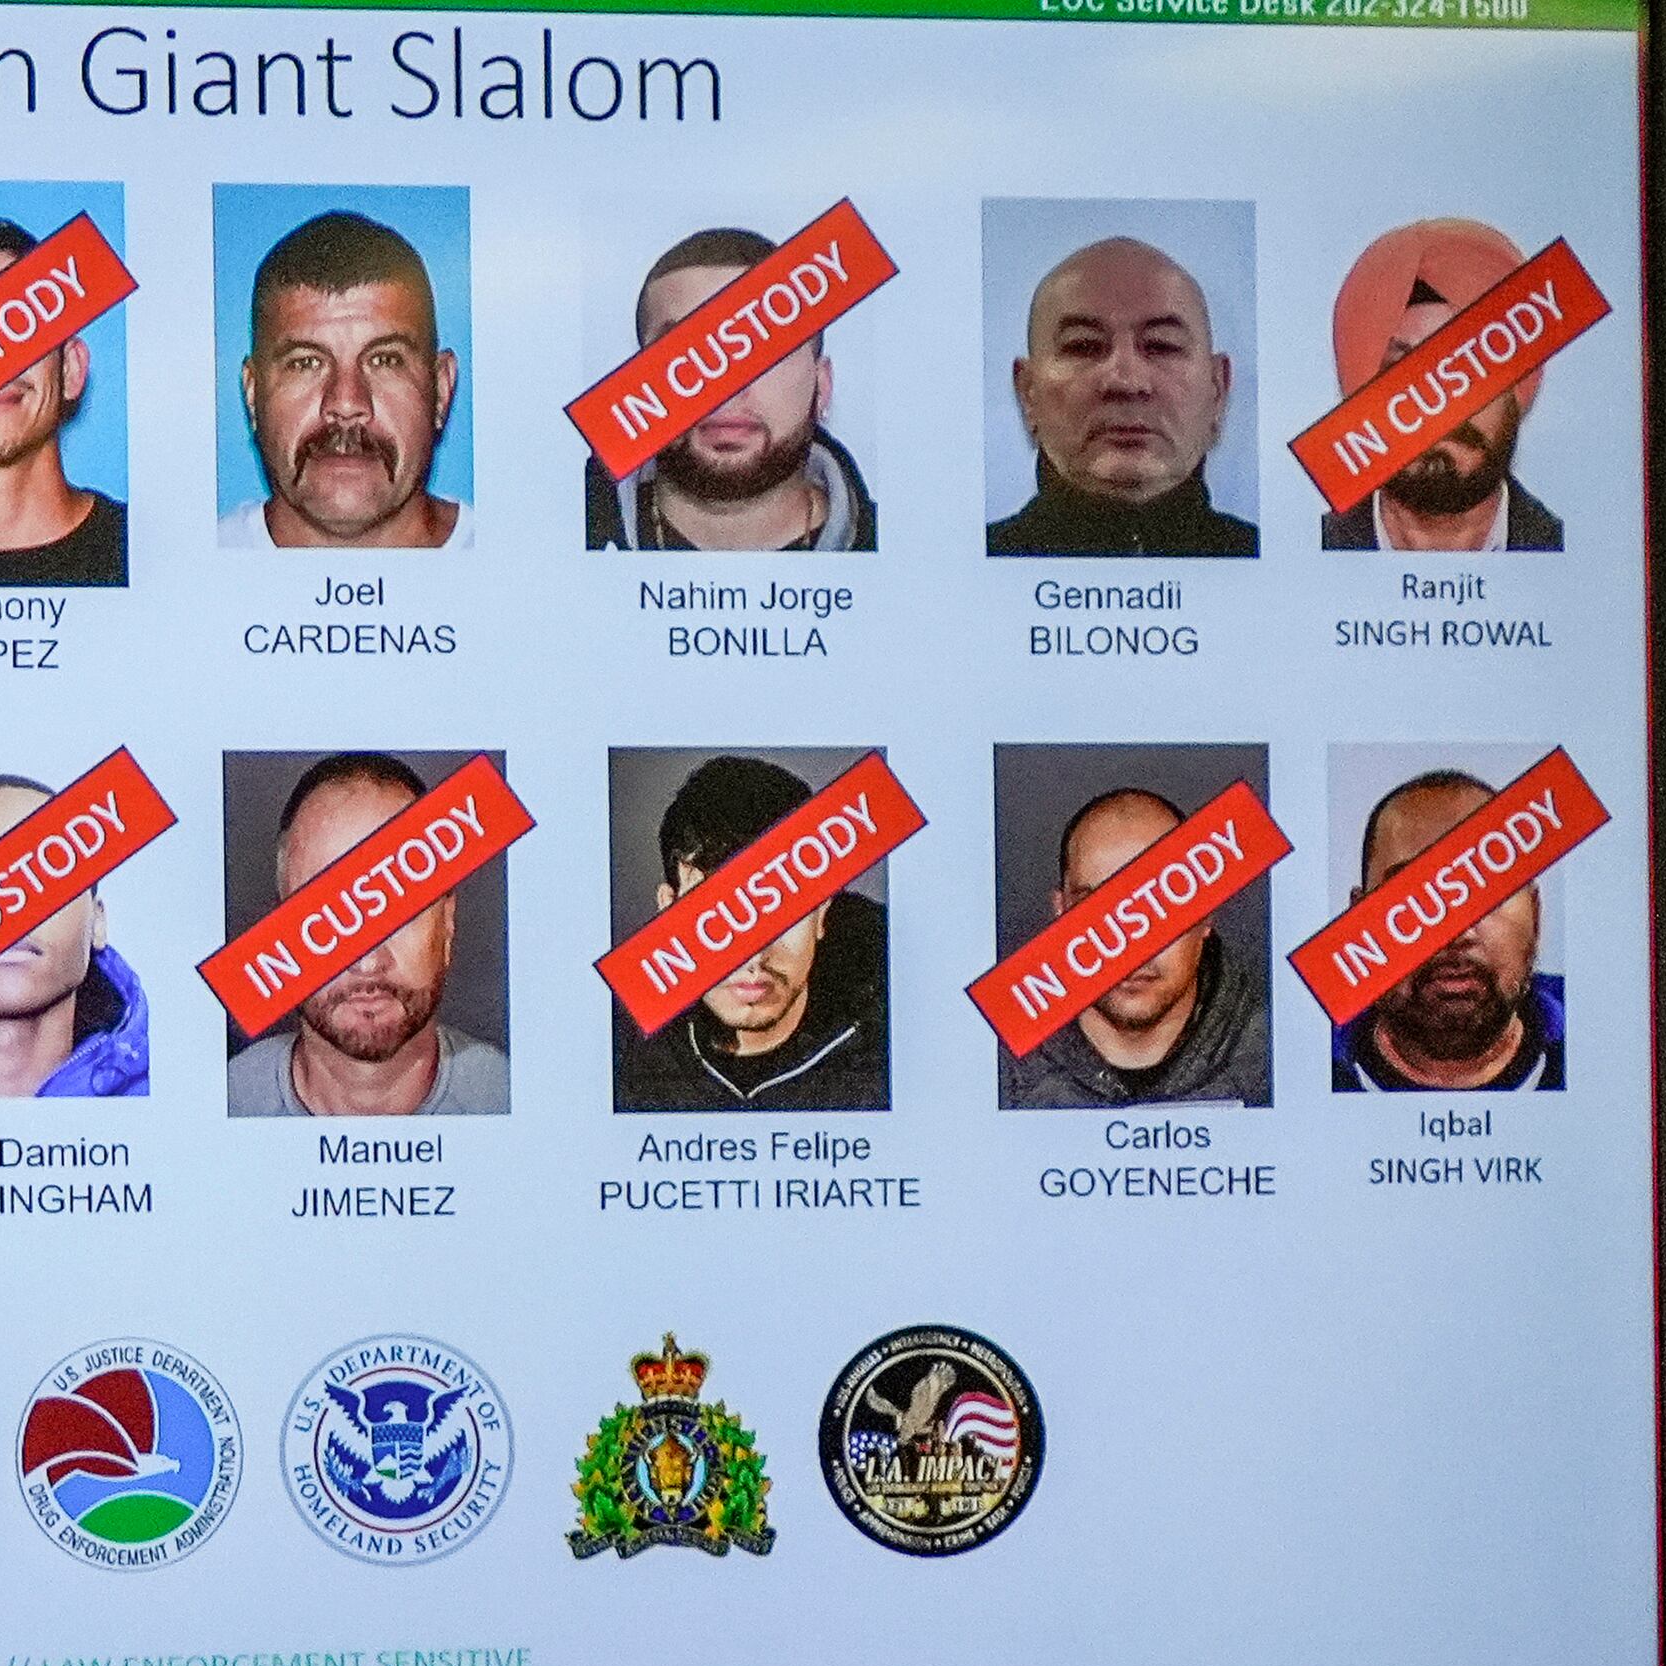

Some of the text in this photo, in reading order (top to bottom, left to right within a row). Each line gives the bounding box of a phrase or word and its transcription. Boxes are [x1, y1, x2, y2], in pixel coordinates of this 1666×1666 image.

[80, 26, 354, 118] Giant
[391, 26, 721, 122] Slalom
[611, 241, 848, 439] IN CUSTODY
[1333, 281, 1562, 474] IN CUSTODY
[315, 576, 384, 606] Joel
[640, 581, 853, 619] Nahim Jorge
[1034, 580, 1181, 610] Gennadii
[1402, 573, 1486, 606] Ranjit
[244, 624, 457, 654] CARDENAS
[669, 626, 828, 657] BONILLA
[1030, 625, 1199, 656] BILONOG
[1335, 620, 1553, 647] SINGH ROWAL
[244, 795, 484, 998] IN CUSTODY
[641, 793, 877, 993] IN CUSTODY
[1333, 790, 1562, 986] IN CUSTODY
[1012, 820, 1243, 1019] IN CUSTODY
[1105, 1119, 1212, 1150] Carlos
[1420, 1109, 1492, 1143] Iqbal
[319, 1134, 442, 1164] Manuel
[638, 1131, 871, 1169] Andres Felipe
[1039, 1165, 1276, 1198] GOYENECHE
[1370, 1157, 1542, 1185] SINGH VIRK
[291, 1186, 455, 1217] JIMENEZ
[600, 1177, 921, 1211] PUCETTI IRIARTE
[85, 1347, 144, 1373] JUSTICE
[151, 1350, 230, 1427] DEPARTMENT
[329, 1344, 486, 1399] DEPARTMENT
[476, 1400, 500, 1432] OF
[916, 1455, 1008, 1482] IMPACT
[28, 1435, 236, 1566] DRUG ENFORCEMENT ADMINISTRATION
[294, 1459, 501, 1555] HOMELAND SECURITY
